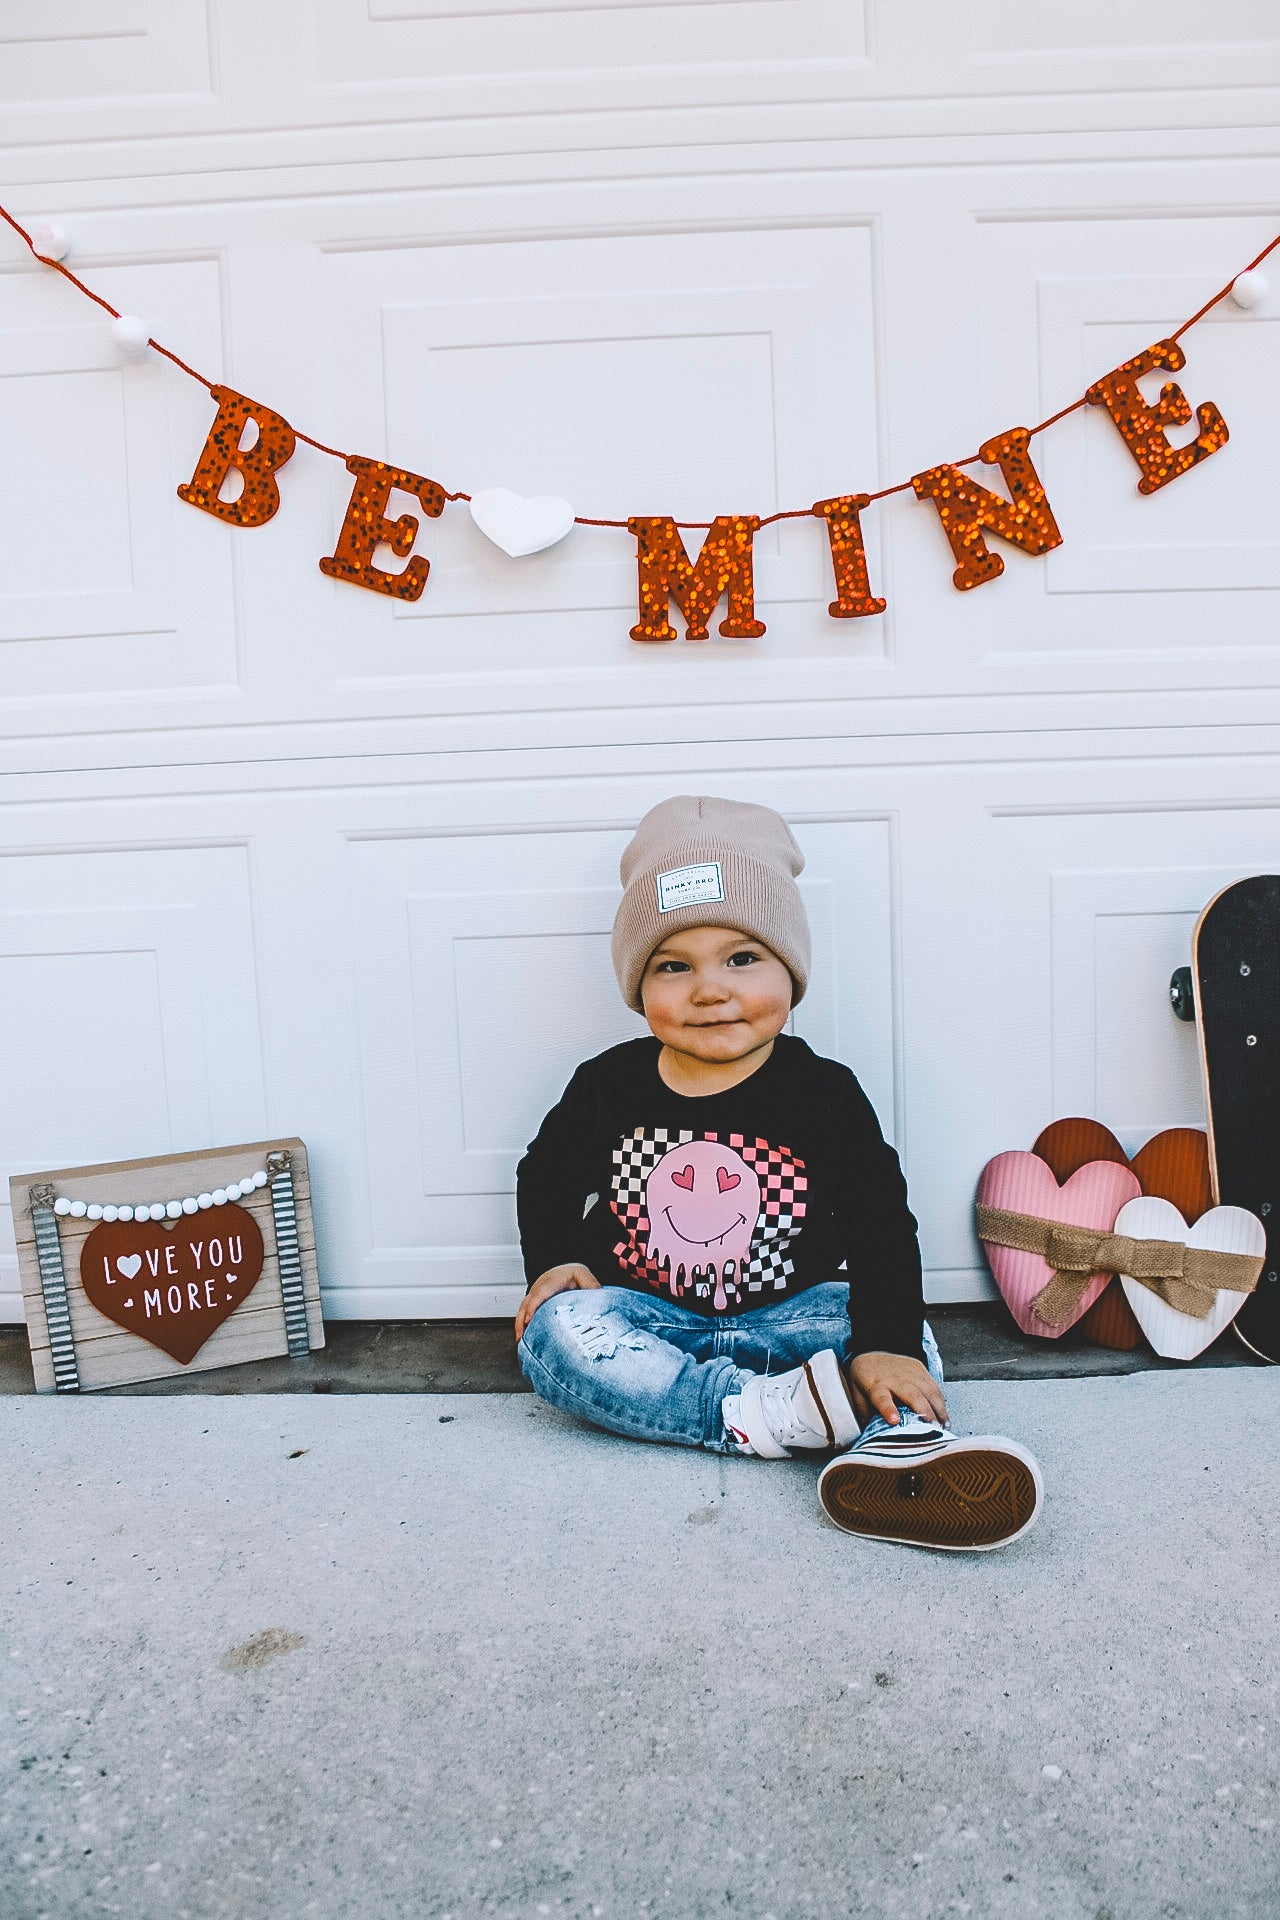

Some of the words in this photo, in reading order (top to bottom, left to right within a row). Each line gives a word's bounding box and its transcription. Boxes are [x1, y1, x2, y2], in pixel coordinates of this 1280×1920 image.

[177, 384, 446, 601] BE
[628, 338, 1230, 641] MINE
[189, 1235, 243, 1270] YOU
[143, 1278, 218, 1318] MORE
